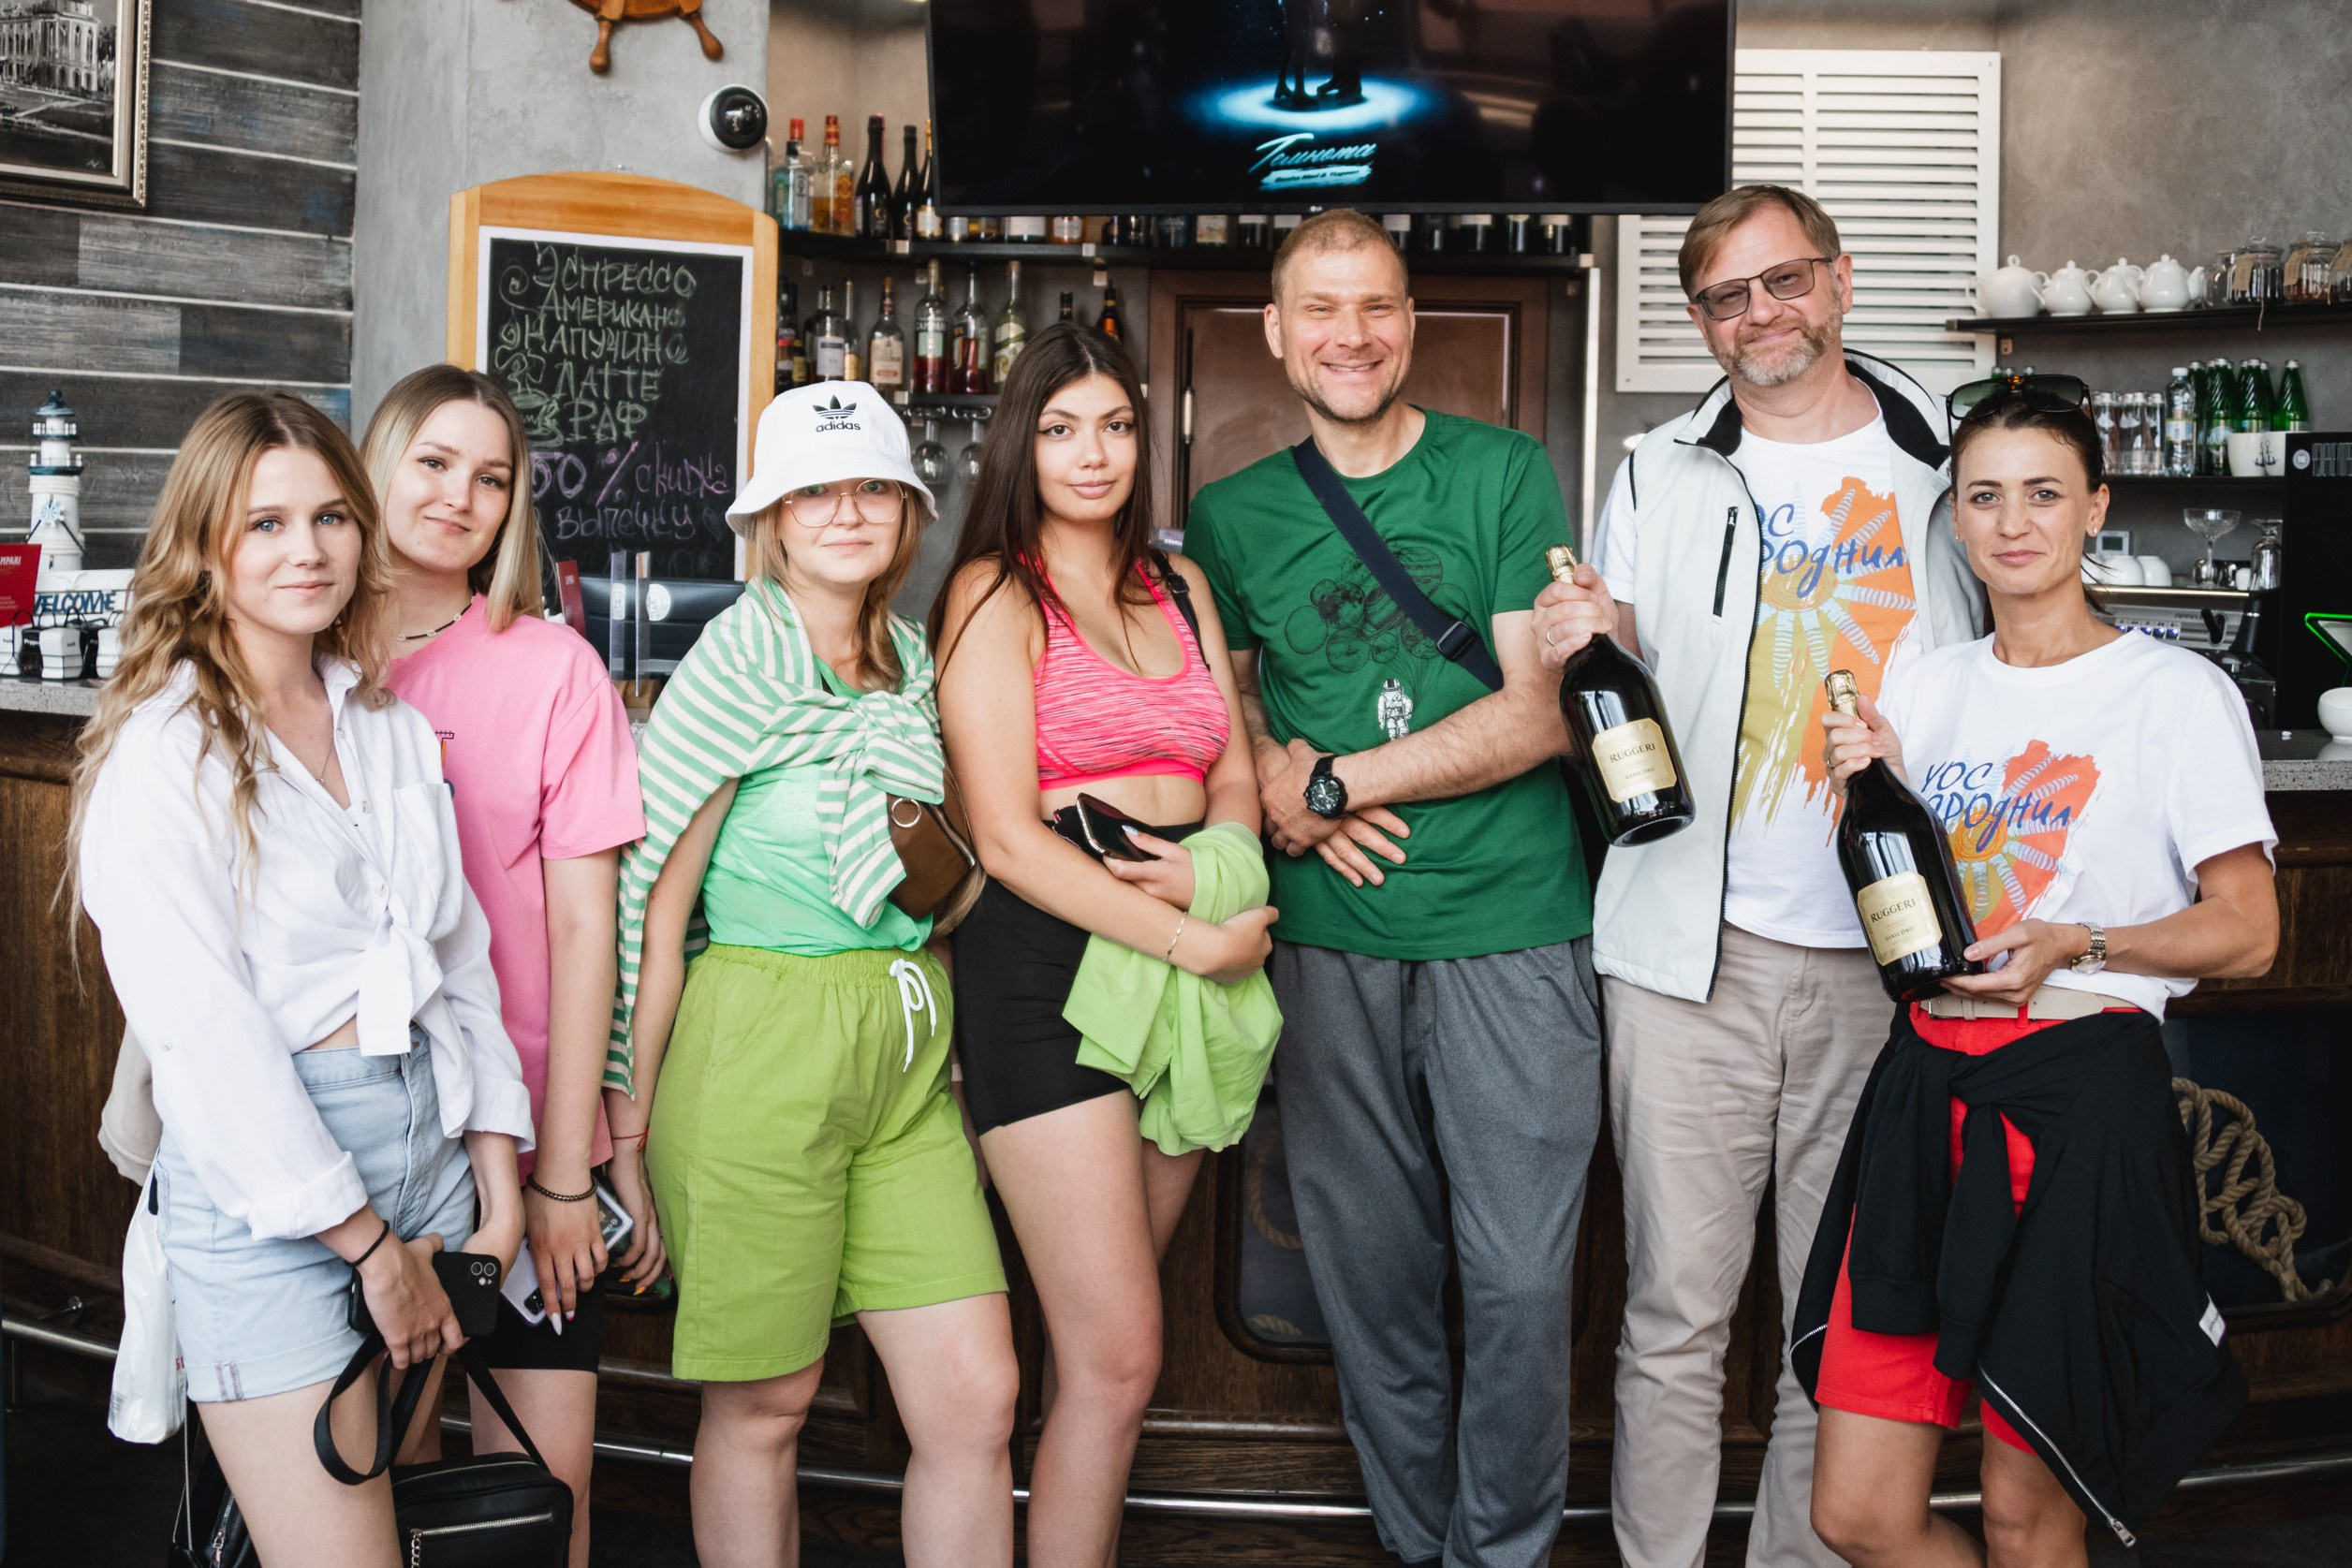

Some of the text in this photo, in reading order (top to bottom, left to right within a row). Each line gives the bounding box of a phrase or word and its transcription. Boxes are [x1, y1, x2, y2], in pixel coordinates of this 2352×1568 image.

[554, 359, 665, 403] ЛАТТЕ
[563, 397, 648, 445] РАФ
[816, 420, 861, 432] adidas
[1610, 742, 1656, 763] RUGGERI
[1870, 898, 1917, 923] RUGGERI
